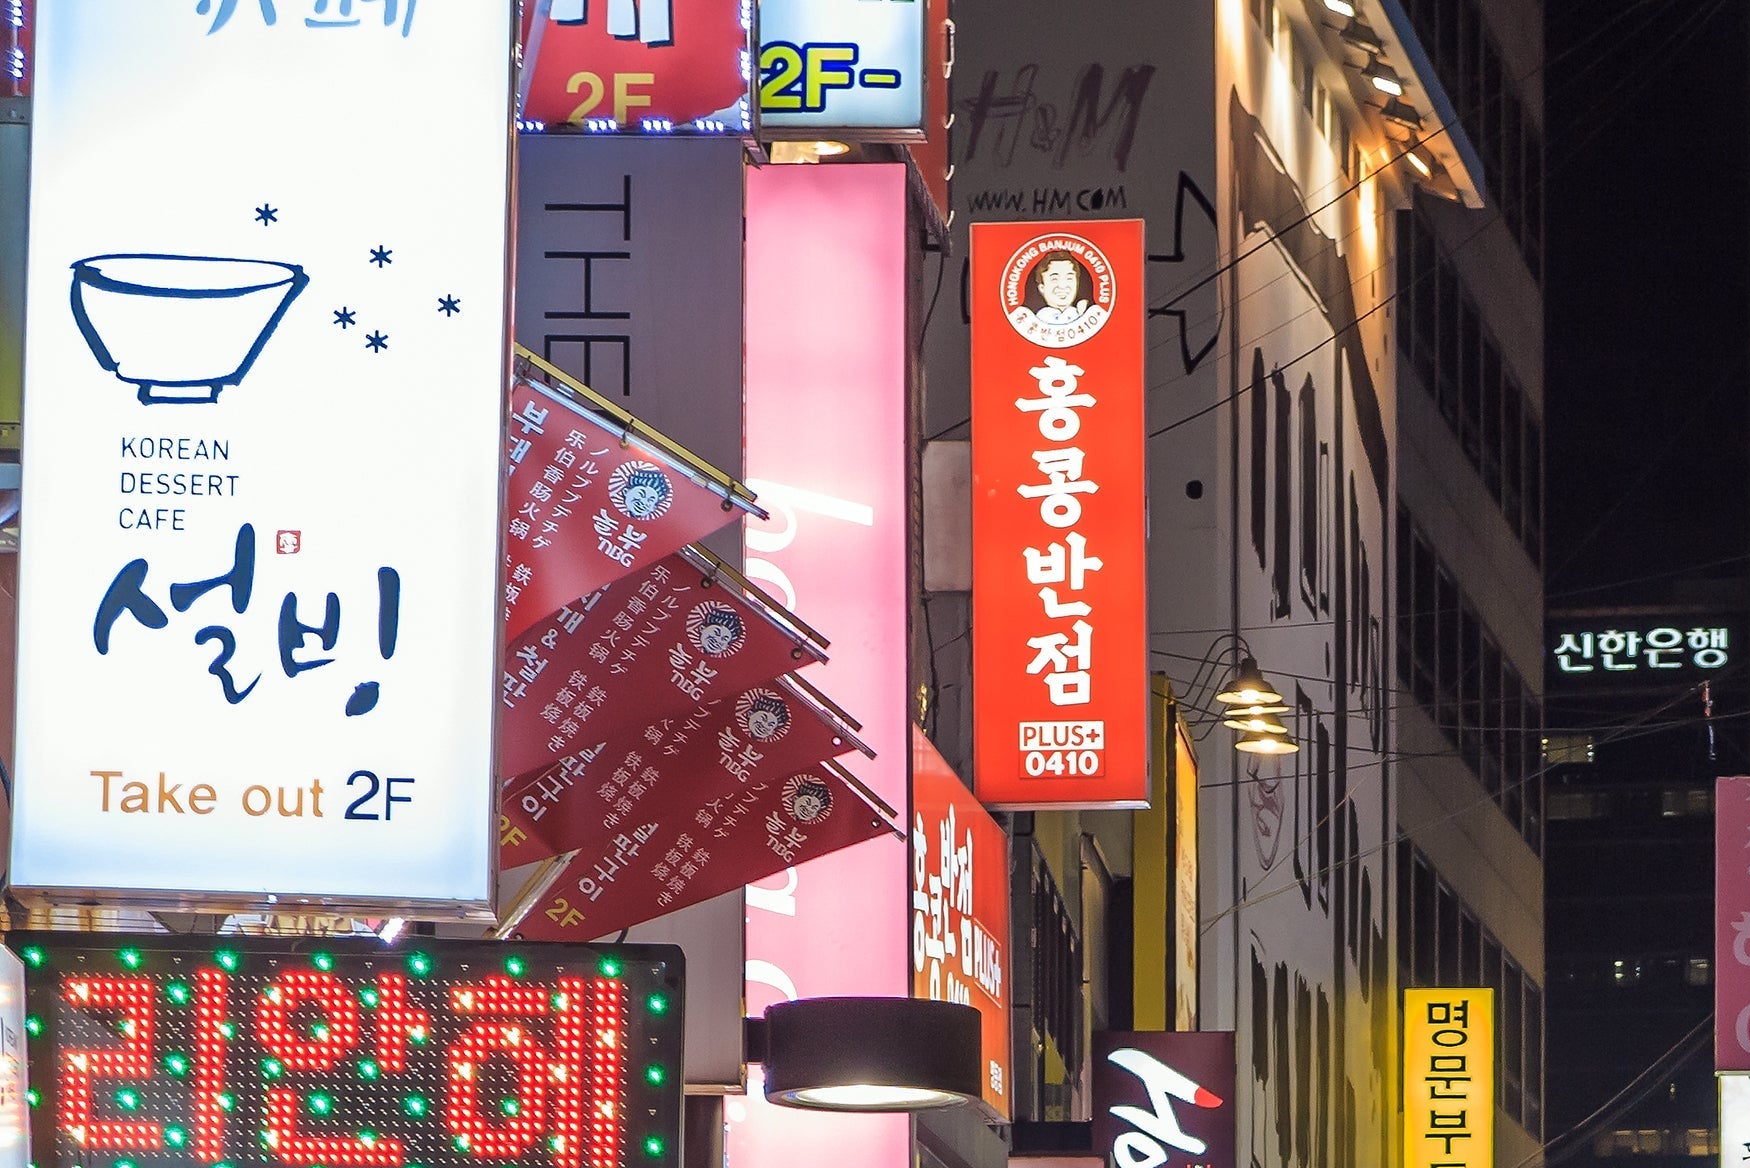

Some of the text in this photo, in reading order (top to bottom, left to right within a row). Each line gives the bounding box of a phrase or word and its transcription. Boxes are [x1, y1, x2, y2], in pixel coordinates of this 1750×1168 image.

[565, 70, 656, 124] 2F
[1006, 246, 1039, 306] HONGKONG
[1037, 240, 1085, 255] BANJUM
[1097, 274, 1110, 303] PLUS
[121, 437, 230, 461] KOREAN
[119, 473, 241, 498] DESSERT
[118, 507, 187, 532] CAFE
[591, 507, 649, 552] 놀부
[1014, 355, 1104, 707] 홍콩반점
[93, 521, 401, 719] 설빙
[667, 641, 719, 687] 놀부
[1554, 626, 1730, 673] 신한은행
[716, 726, 765, 770] 놀부
[1022, 725, 1101, 748] PLUS+
[1024, 750, 1100, 777] 0410
[90, 769, 415, 821] Take out 2F
[763, 810, 808, 851] 놀부
[544, 896, 587, 931] 2F
